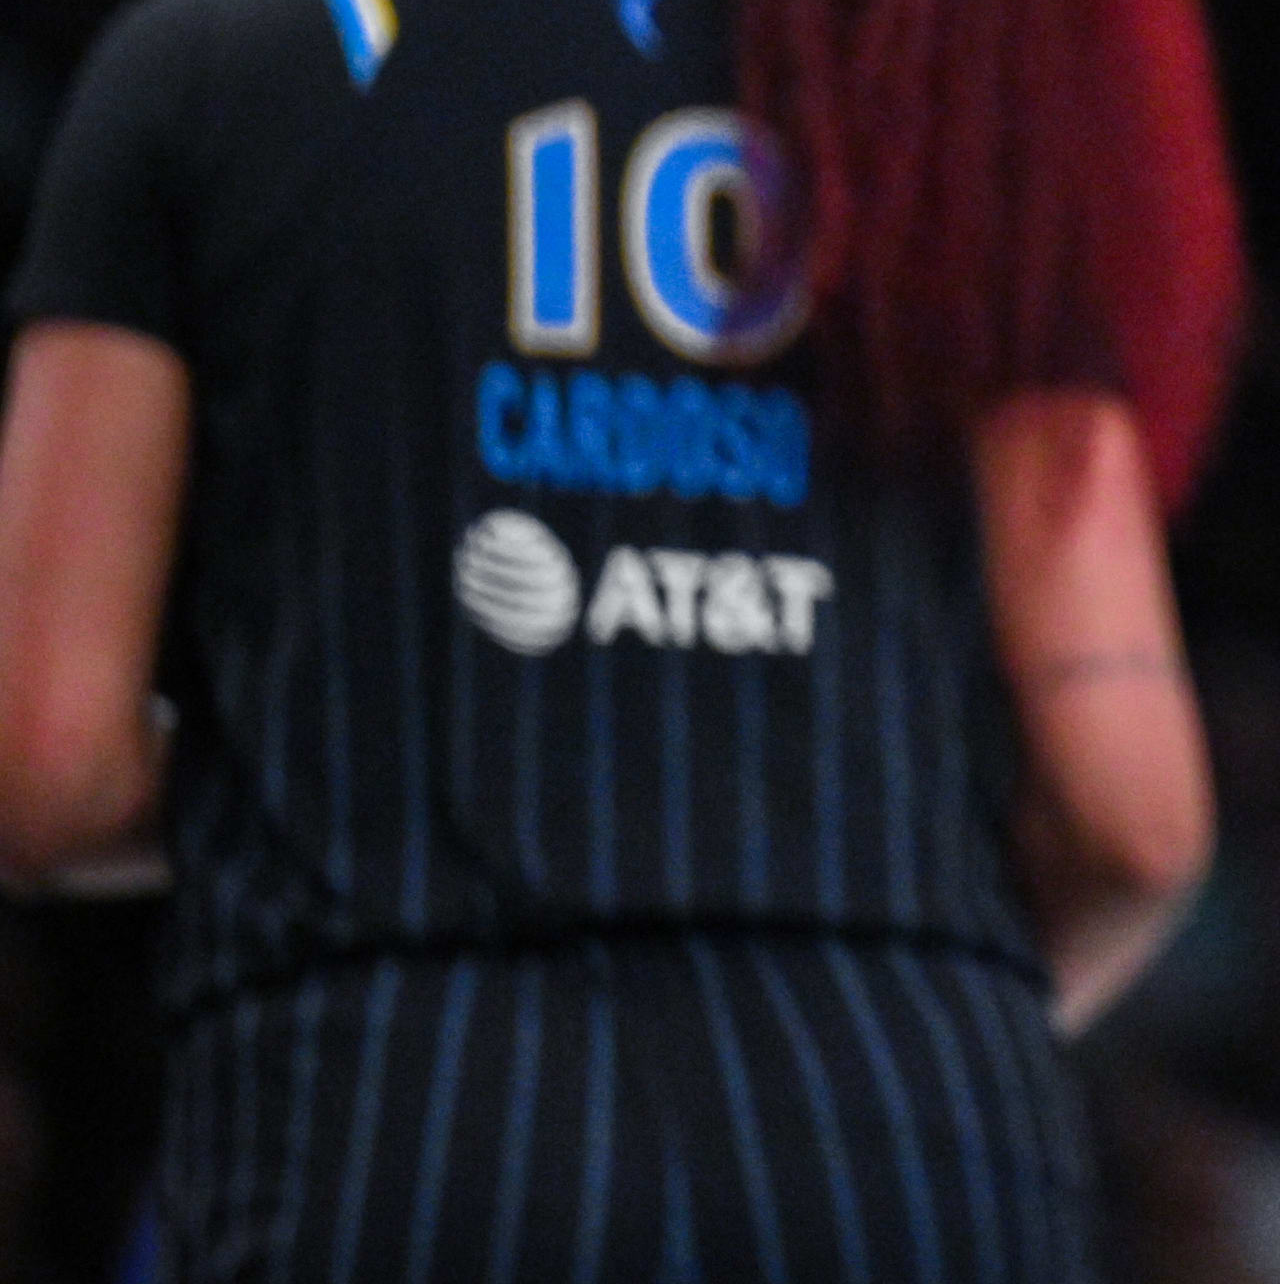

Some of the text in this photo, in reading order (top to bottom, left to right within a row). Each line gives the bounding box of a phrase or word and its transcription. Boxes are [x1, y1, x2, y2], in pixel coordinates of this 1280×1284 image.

[508, 98, 815, 368] 10
[476, 361, 811, 506] CARDOSO
[586, 545, 834, 654] AT&T
